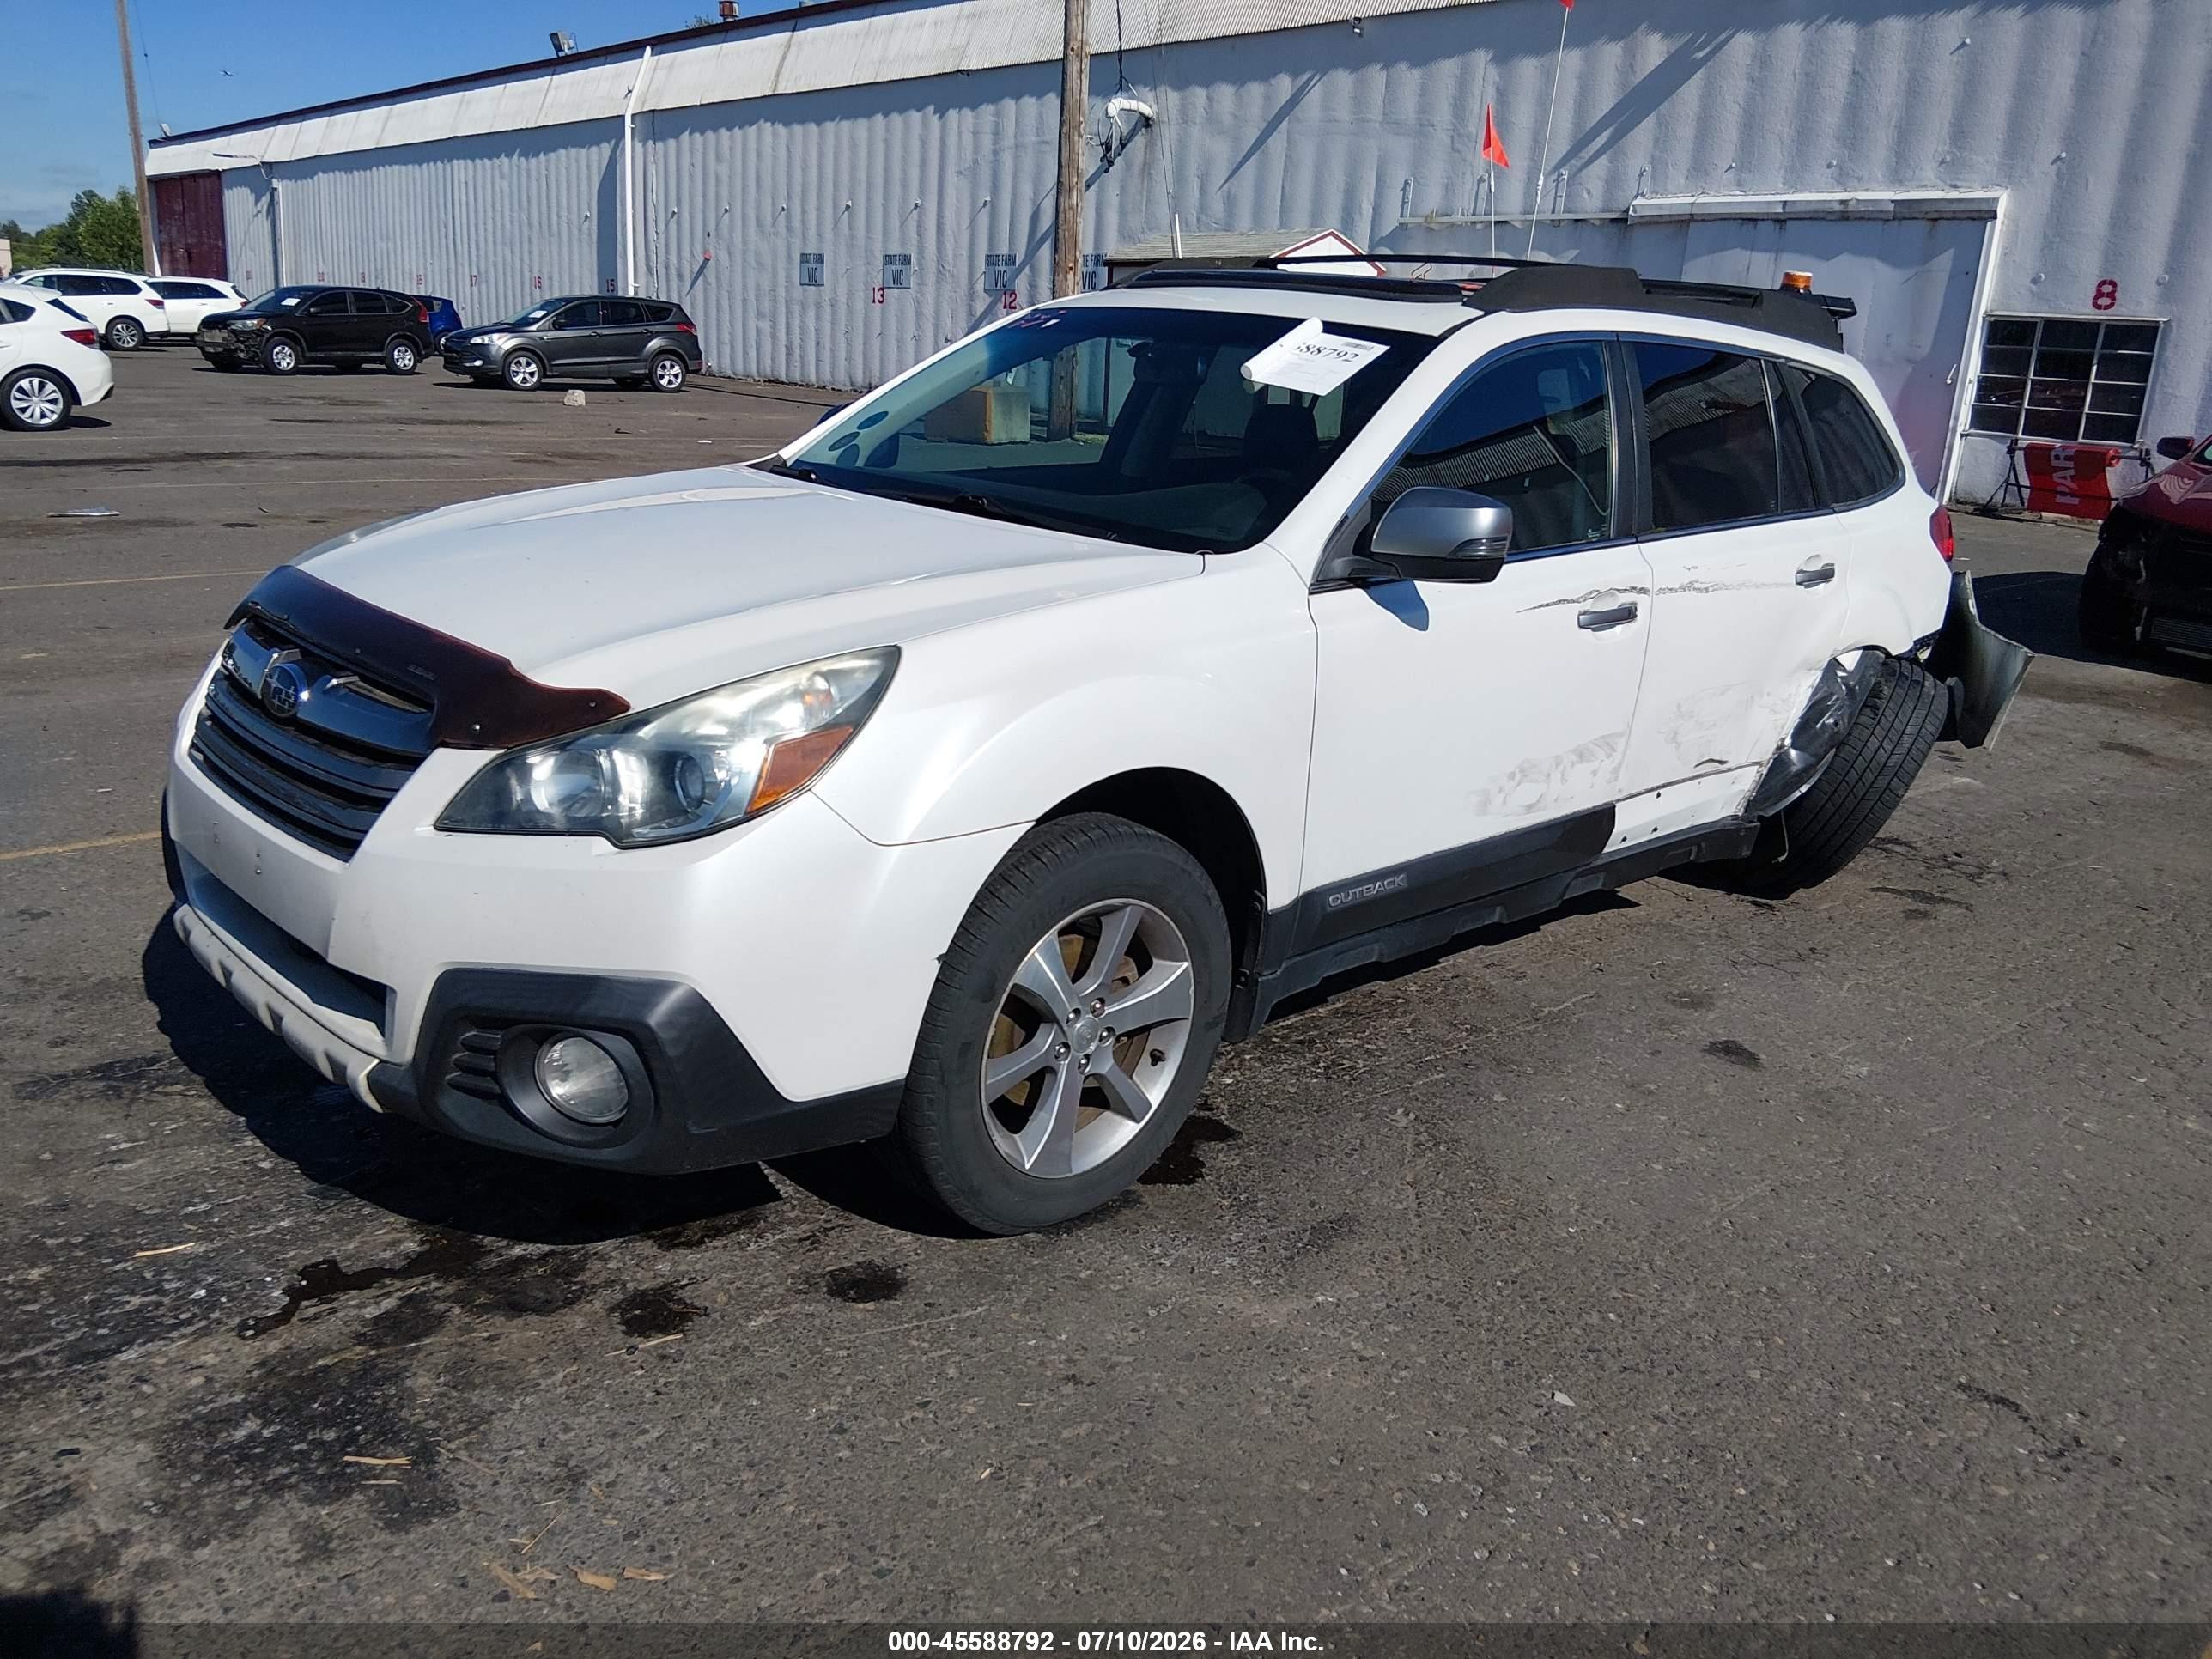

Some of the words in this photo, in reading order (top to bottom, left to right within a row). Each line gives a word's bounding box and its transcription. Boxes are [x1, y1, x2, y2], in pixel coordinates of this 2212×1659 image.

[884, 254, 897, 265] STATE
[899, 254, 911, 265] FARM
[986, 254, 1000, 266] STATE
[1001, 254, 1017, 266] FARM
[470, 274, 477, 287] 17
[533, 276, 542, 289] 16
[807, 267, 818, 283] VIC
[892, 269, 904, 285] VIC
[994, 270, 1007, 288] VIC
[1082, 271, 1096, 289] VIC
[605, 278, 615, 293] 15
[872, 287, 884, 303] 13
[1002, 290, 1017, 309] 12
[2092, 279, 2118, 310] 8
[1328, 873, 1407, 908] OUTBACK
